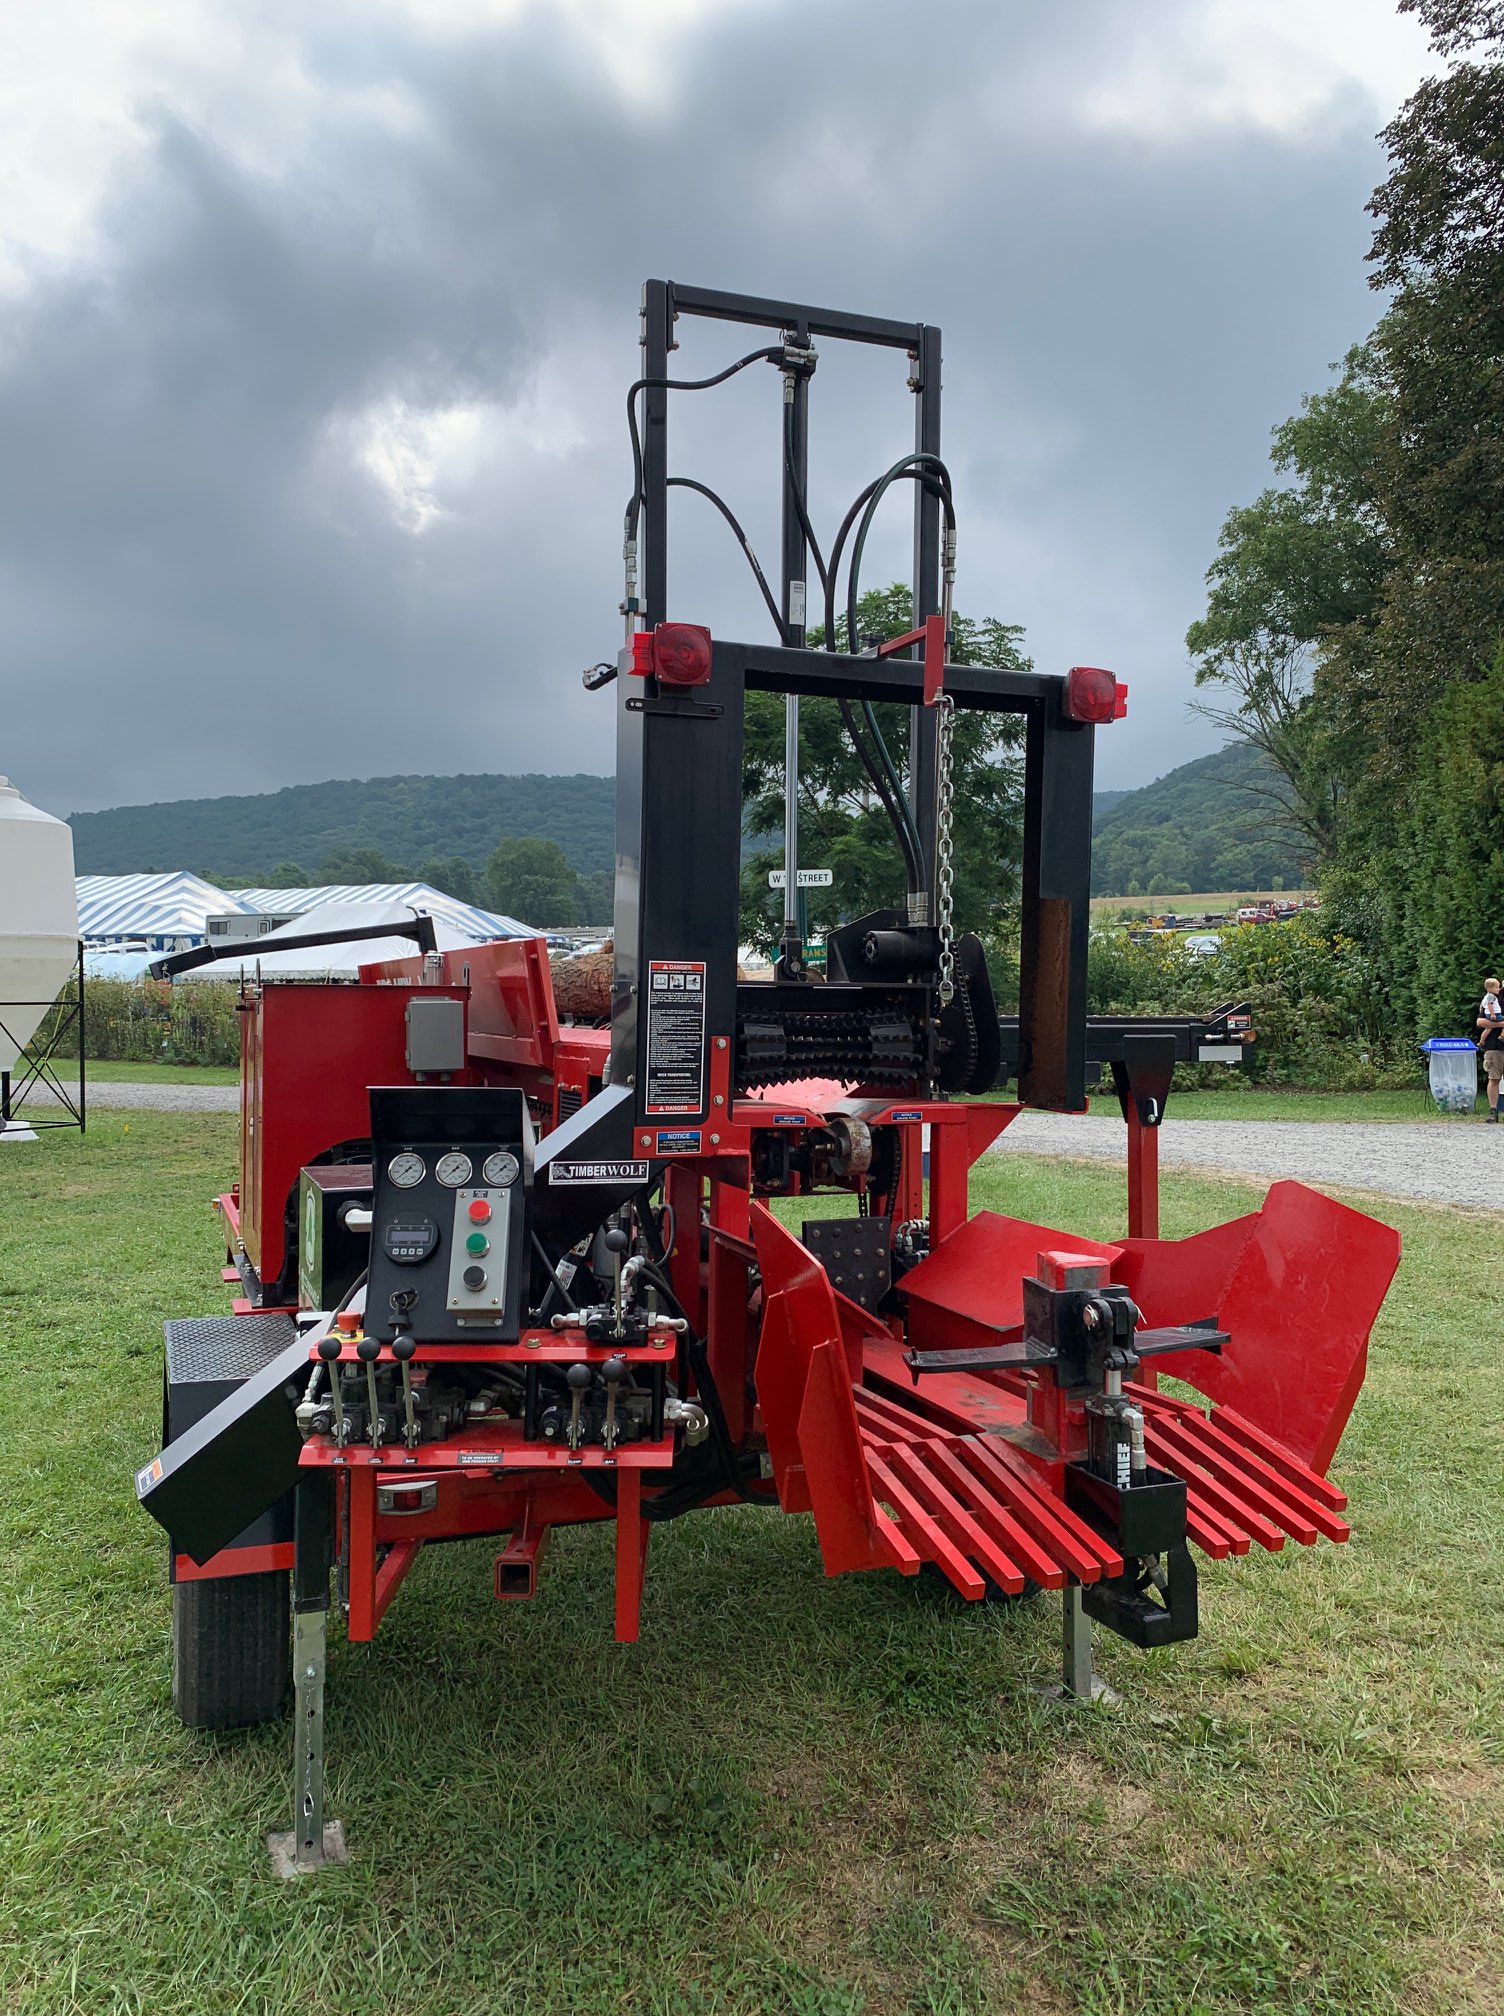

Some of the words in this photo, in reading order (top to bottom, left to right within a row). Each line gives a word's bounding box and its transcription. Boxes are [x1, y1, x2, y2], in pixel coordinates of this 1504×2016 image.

[772, 875, 781, 883] W
[797, 873, 829, 883] STREET
[568, 1164, 646, 1177] TIMBERWOLF
